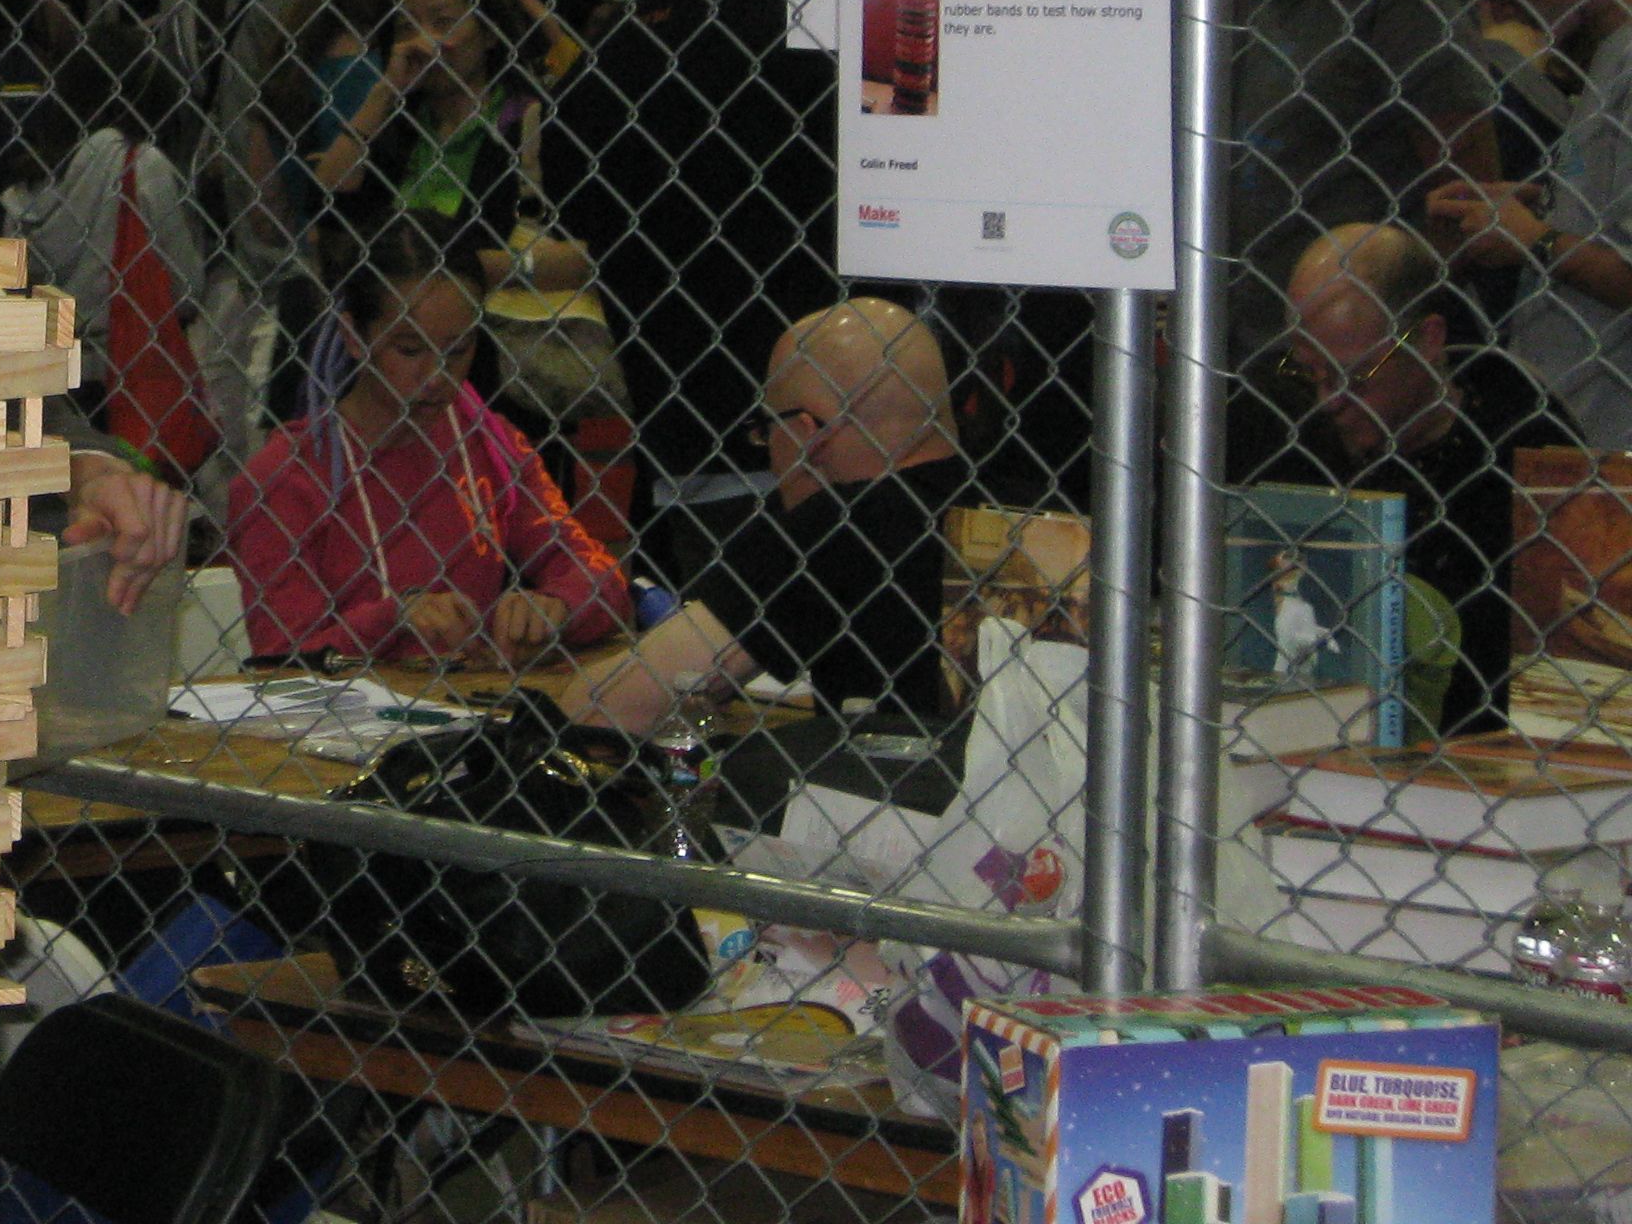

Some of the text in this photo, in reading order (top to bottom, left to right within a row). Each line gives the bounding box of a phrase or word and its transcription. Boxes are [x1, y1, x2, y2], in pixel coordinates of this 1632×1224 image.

[944, 4, 1143, 20] rubber bands to test how strong
[944, 23, 997, 36] they are.
[860, 158, 918, 171] Colin Freed
[858, 204, 900, 222] Make:
[1093, 1180, 1126, 1207] ECO
